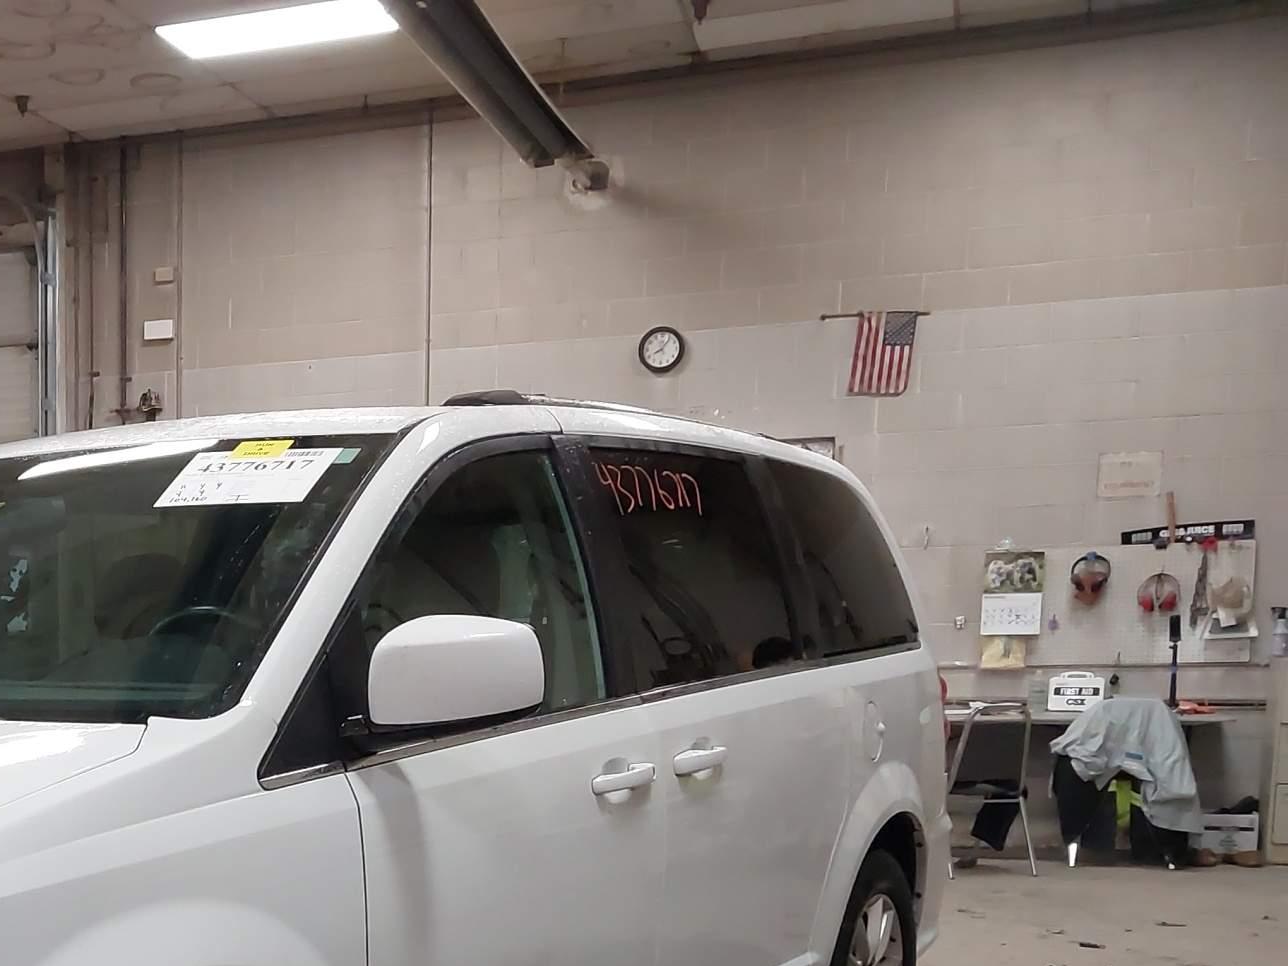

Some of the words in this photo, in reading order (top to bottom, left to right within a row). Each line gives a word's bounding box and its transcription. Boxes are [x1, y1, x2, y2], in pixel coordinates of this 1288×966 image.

[197, 459, 314, 473] 43776717
[592, 462, 702, 516] 43776717
[1060, 687, 1079, 696] FIRST
[1081, 688, 1094, 696] AID
